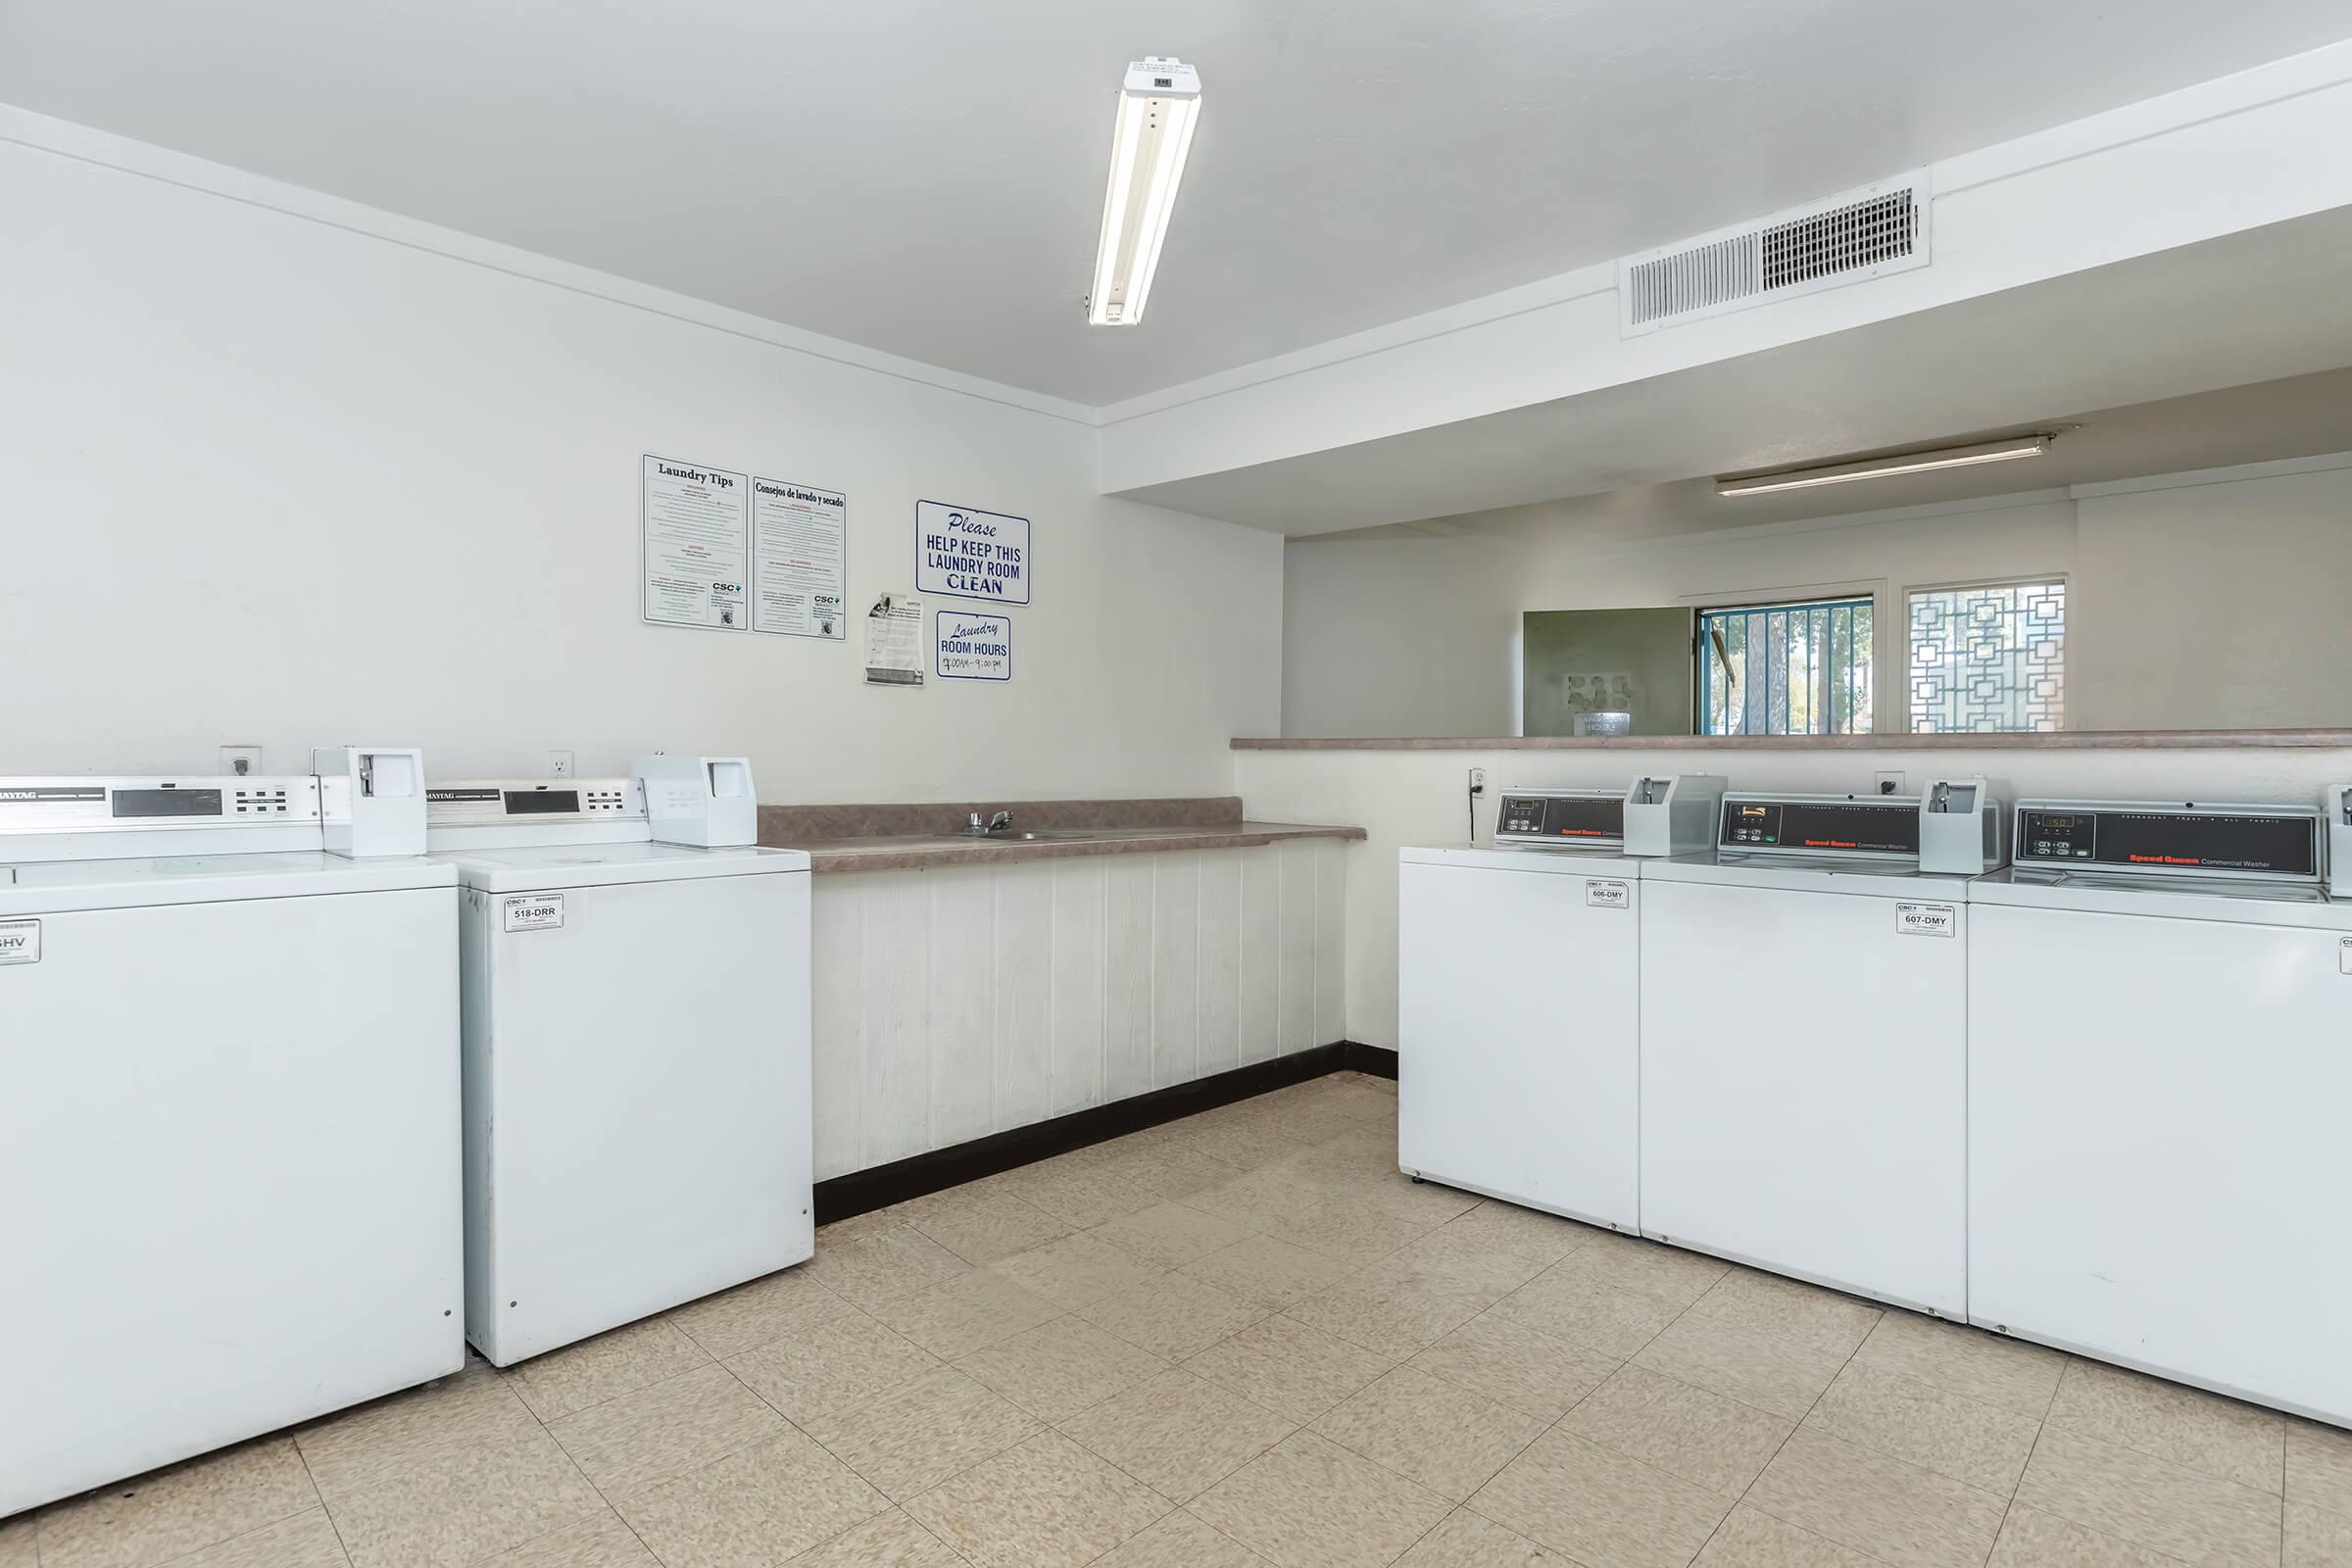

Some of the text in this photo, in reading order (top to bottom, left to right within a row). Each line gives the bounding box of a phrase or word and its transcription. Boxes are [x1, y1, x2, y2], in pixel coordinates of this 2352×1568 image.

[659, 464, 733, 488] Laundry Tips
[756, 482, 844, 508] Consejos de lavado y secado
[948, 513, 997, 537] Please
[926, 534, 1021, 563] HELP KEEP THIS
[928, 553, 1020, 579] LAUNDRY ROOM
[712, 582, 735, 592] CSC
[947, 573, 1003, 594] CLEAN
[814, 595, 834, 604] CSC
[951, 621, 998, 639] Laundry
[942, 640, 1006, 657] ROOM HOURS
[514, 907, 556, 918] 518-DRR
[1905, 915, 1946, 925] 607-DMY
